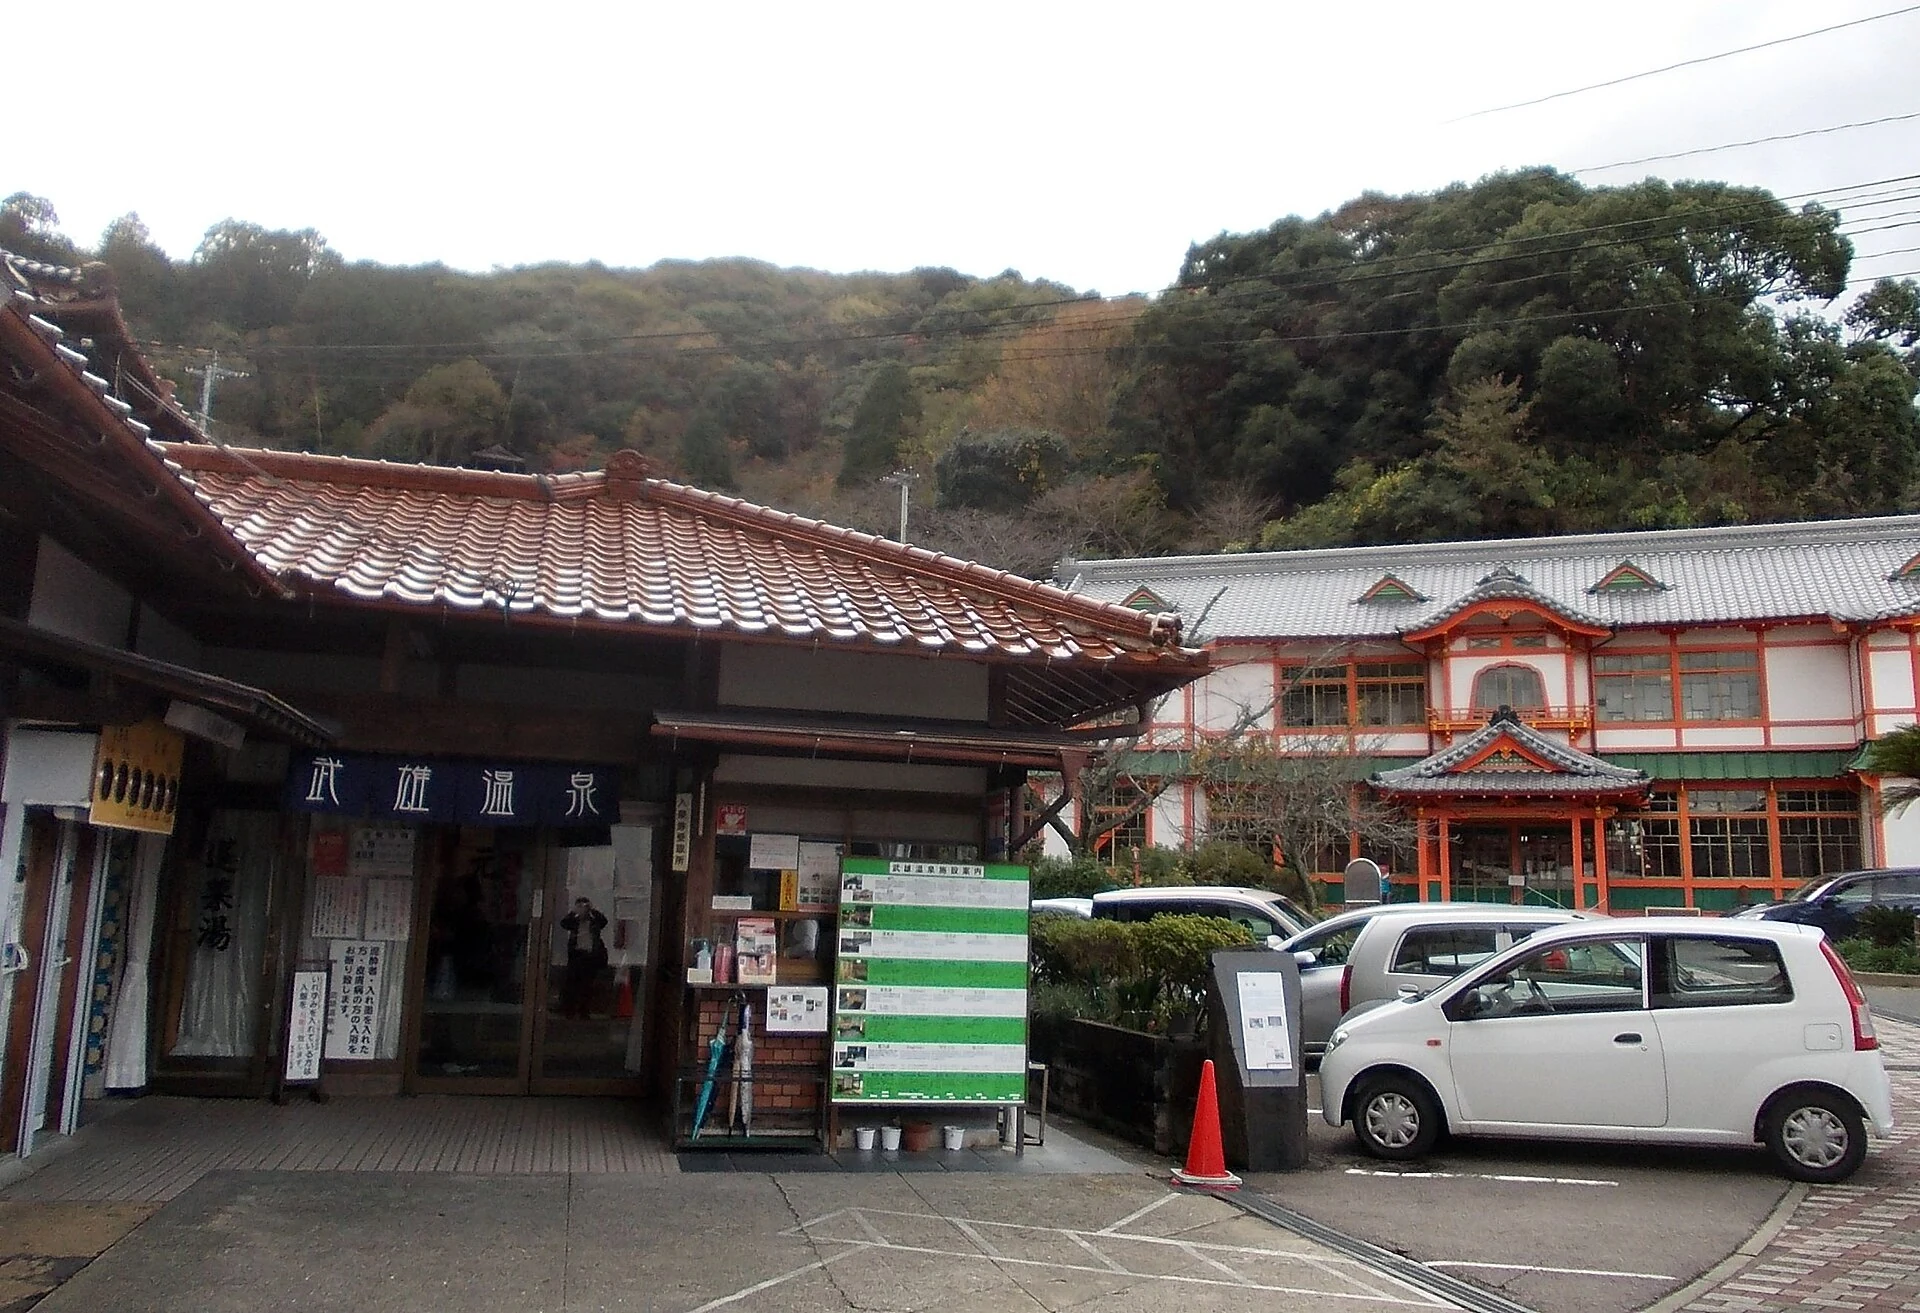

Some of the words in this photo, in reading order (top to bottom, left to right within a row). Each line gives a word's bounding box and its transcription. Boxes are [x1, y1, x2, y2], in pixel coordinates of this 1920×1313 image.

[305, 757, 600, 817] 武雄温泉
[892, 864, 982, 876] 武雄温泉施設案内
[340, 946, 356, 1018] お断り致します。
[347, 946, 368, 1054] 方・皮膚病の方の入浴を
